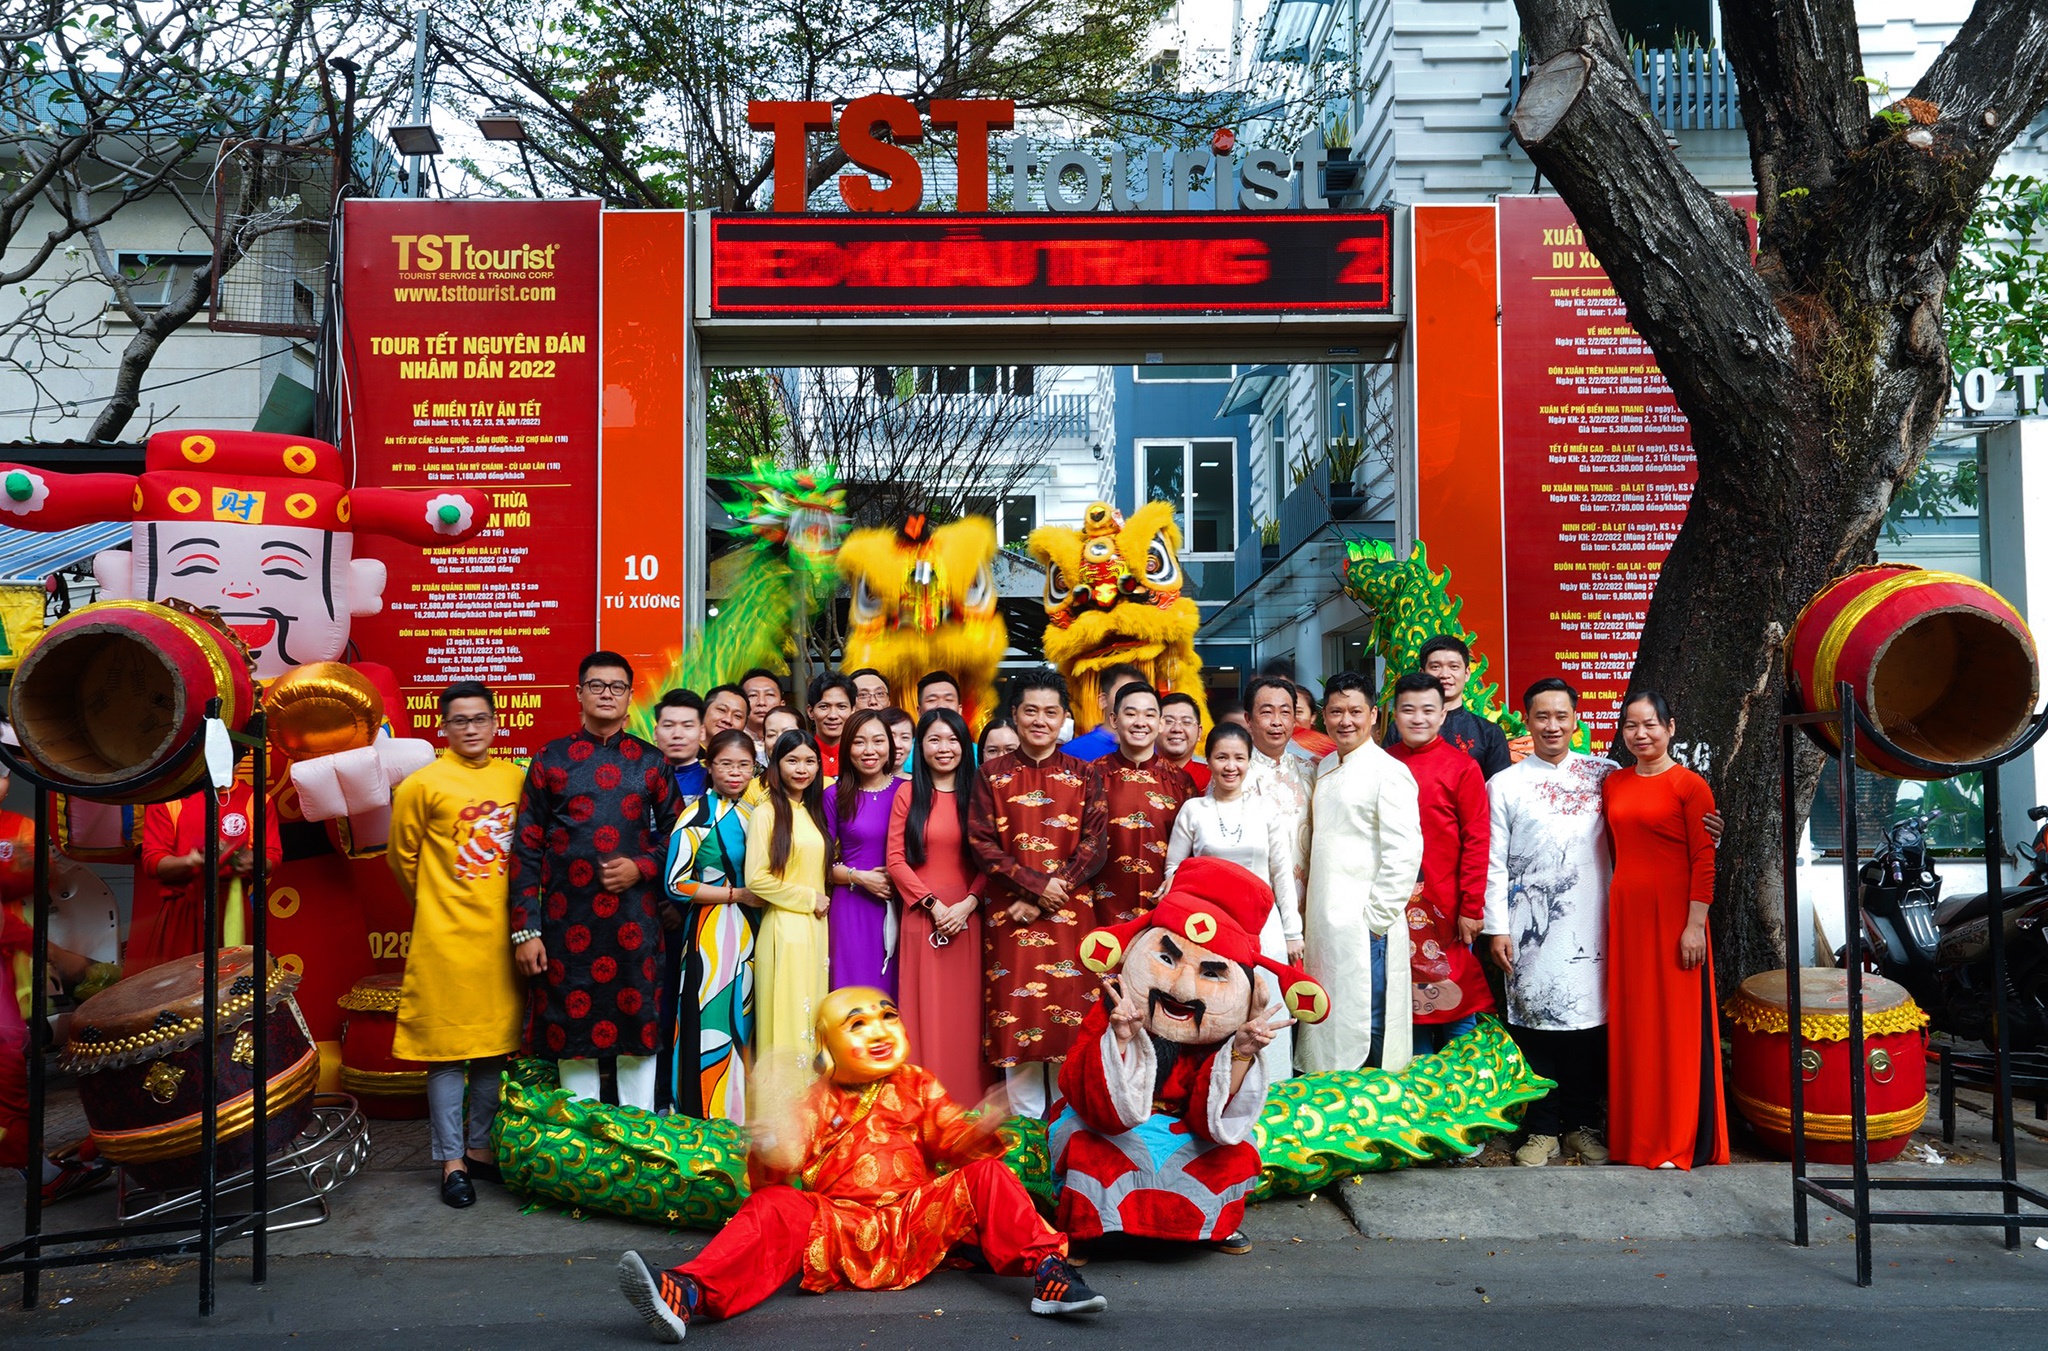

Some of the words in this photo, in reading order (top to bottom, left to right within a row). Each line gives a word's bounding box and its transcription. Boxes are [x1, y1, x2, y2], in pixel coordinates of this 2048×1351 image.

[748, 94, 1328, 212] TSTtourist
[1543, 223, 1583, 246] XUẤT
[1552, 251, 1575, 269] DU
[399, 272, 436, 280] TOURIST
[439, 272, 477, 280] SERVICE
[479, 272, 485, 280] &
[394, 285, 556, 302] www.tsttourist.com
[1550, 288, 1570, 297] XUÂN
[1555, 299, 1572, 308] Ngày
[1587, 298, 1617, 307] 2/2/2022
[371, 337, 420, 355] TOUR
[426, 332, 457, 355] TẾT
[463, 333, 540, 354] NGUYÊN
[545, 332, 585, 354] ĐÁN
[400, 358, 458, 379] NHÂM
[464, 356, 503, 379] DẦN
[509, 360, 556, 378] 2022
[1548, 366, 1563, 375] ĐÓN
[1565, 366, 1584, 375] XUÂN
[1586, 365, 1604, 375] TRÊN
[1605, 366, 1628, 374] THÀNH
[1630, 364, 1644, 374] PHỐ
[413, 400, 429, 418] VỀ
[433, 400, 467, 417] MIỀN
[471, 401, 493, 417] TÂY
[497, 401, 516, 417] ĂN
[520, 399, 541, 417] TẾT
[1539, 405, 1559, 414] XUÂN
[1560, 404, 1569, 414] VỀ
[1571, 404, 1585, 414] PHỐ
[1621, 405, 1644, 413] TRANG
[1646, 405, 1653, 414] (4
[396, 435, 407, 445] TẾT
[1549, 443, 1561, 453] TẾT
[1590, 445, 1604, 453] CAO
[1611, 444, 1621, 453] ĐÀ
[1623, 445, 1635, 454] LẠT
[1637, 445, 1645, 453] (4
[1669, 444, 1679, 452] KS
[1680, 444, 1685, 452] 4
[1542, 484, 1552, 492] DU
[1553, 483, 1573, 492] XUÂN
[1574, 484, 1589, 492] NHA
[1591, 484, 1613, 492] TRANG
[1621, 483, 1631, 492] ĐÀ
[1632, 484, 1645, 493] LẠT
[1647, 484, 1654, 492] (5
[1678, 483, 1688, 491] KS
[493, 491, 528, 508] THỪA
[504, 511, 531, 527] MỚI
[1602, 522, 1612, 531] ĐÀ
[1613, 523, 1626, 532] LẠT
[1628, 523, 1635, 532] (4
[1660, 523, 1670, 531] KS
[1671, 523, 1676, 531] 4
[433, 547, 451, 555] XUÂN
[452, 546, 466, 555] PHỐ
[490, 547, 501, 556] LẠT
[625, 555, 659, 581] 10
[1554, 562, 1574, 571] BUÔN
[1575, 563, 1587, 571] MA
[1588, 562, 1610, 572] THUỘT
[1616, 562, 1629, 572] GIA
[1630, 562, 1641, 571] LAI
[412, 584, 421, 592] DU
[422, 583, 440, 592] XUÂN
[511, 583, 520, 592] KS
[521, 583, 526, 591] 5
[605, 592, 624, 609] TÚ
[629, 593, 680, 609] XƯƠNG
[1550, 611, 1560, 620] ĐÀ
[1588, 610, 1602, 620] HUẾ
[1603, 612, 1611, 621] (4
[1635, 612, 1646, 620] KS
[414, 629, 430, 637] GIAO
[467, 628, 488, 636] THÀNH
[489, 627, 503, 636] PHỐ
[533, 626, 550, 636] QUỐC
[1555, 650, 1580, 660] QUẢNG
[1581, 652, 1599, 660] NINH
[1600, 652, 1608, 661] (4
[406, 691, 439, 709] XUẤT
[493, 691, 508, 709] ẦU
[511, 692, 541, 709] NĂM
[1582, 691, 1597, 699] MAI
[1598, 690, 1617, 700] CHÂU
[414, 715, 431, 728] DU
[510, 711, 534, 730] LỘC
[500, 746, 512, 755] TÀU
[368, 931, 412, 959] 028
